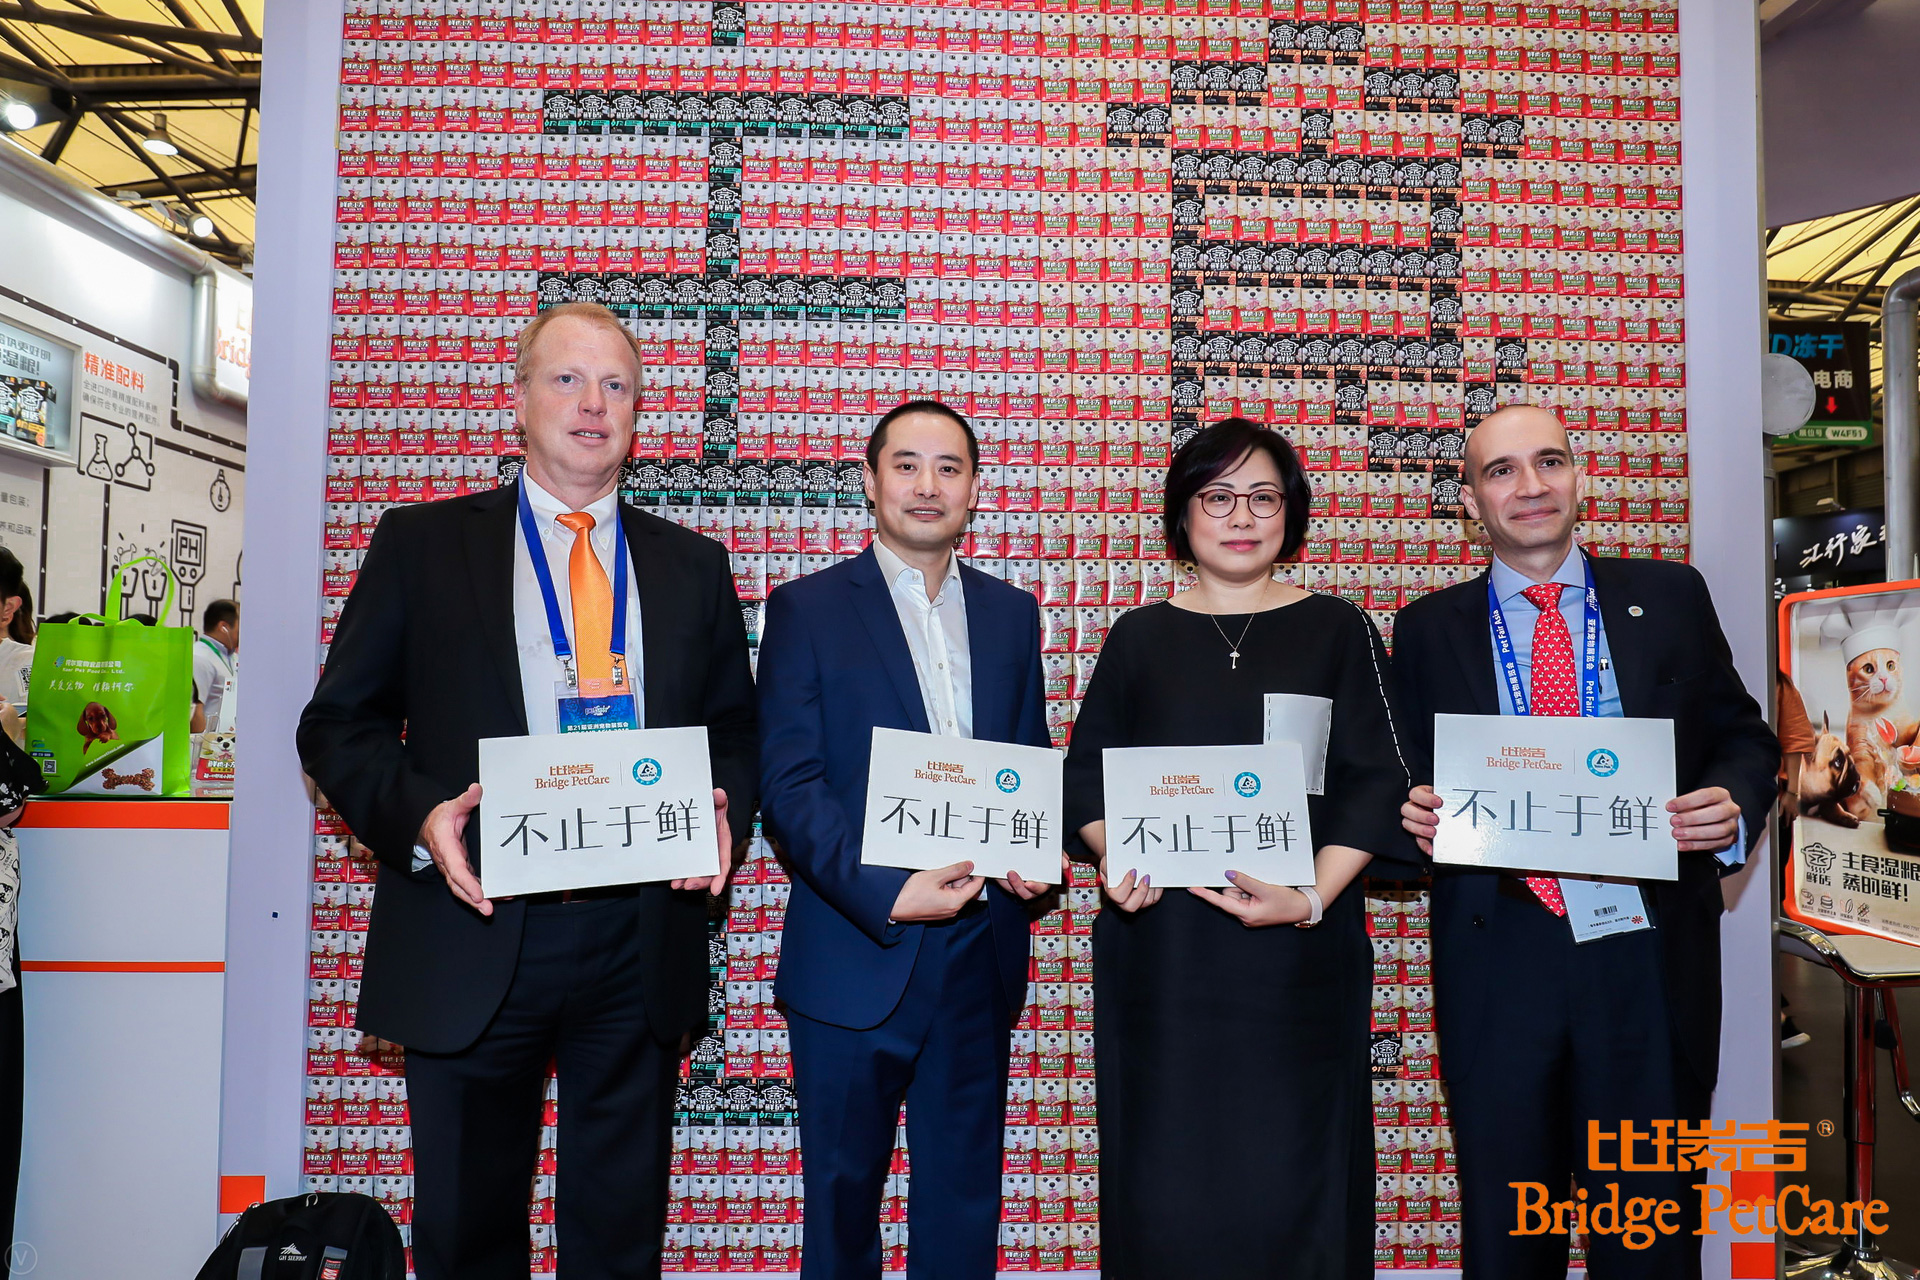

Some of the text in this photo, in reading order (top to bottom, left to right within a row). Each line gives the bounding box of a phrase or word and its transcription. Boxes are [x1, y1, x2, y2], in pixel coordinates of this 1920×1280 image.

[1769, 333, 1844, 359] D冻干
[84, 351, 145, 393] 精准配料
[180, 537, 198, 560] PH
[1492, 609, 1510, 654] Pet Fair Asia
[1586, 680, 1594, 712] Pet Fair
[914, 769, 976, 785] Bridge PetCare
[1486, 757, 1562, 771] Bridge PetCare
[534, 775, 610, 790] Bridge PetCare
[1150, 786, 1214, 797] Bridge PetCare
[500, 798, 700, 856] 不止于鲜
[880, 796, 1048, 849] 不止于鲜
[1452, 788, 1658, 840] 不止于鲜
[1122, 812, 1297, 854] 不止于鲜
[1594, 882, 1604, 890] VIP
